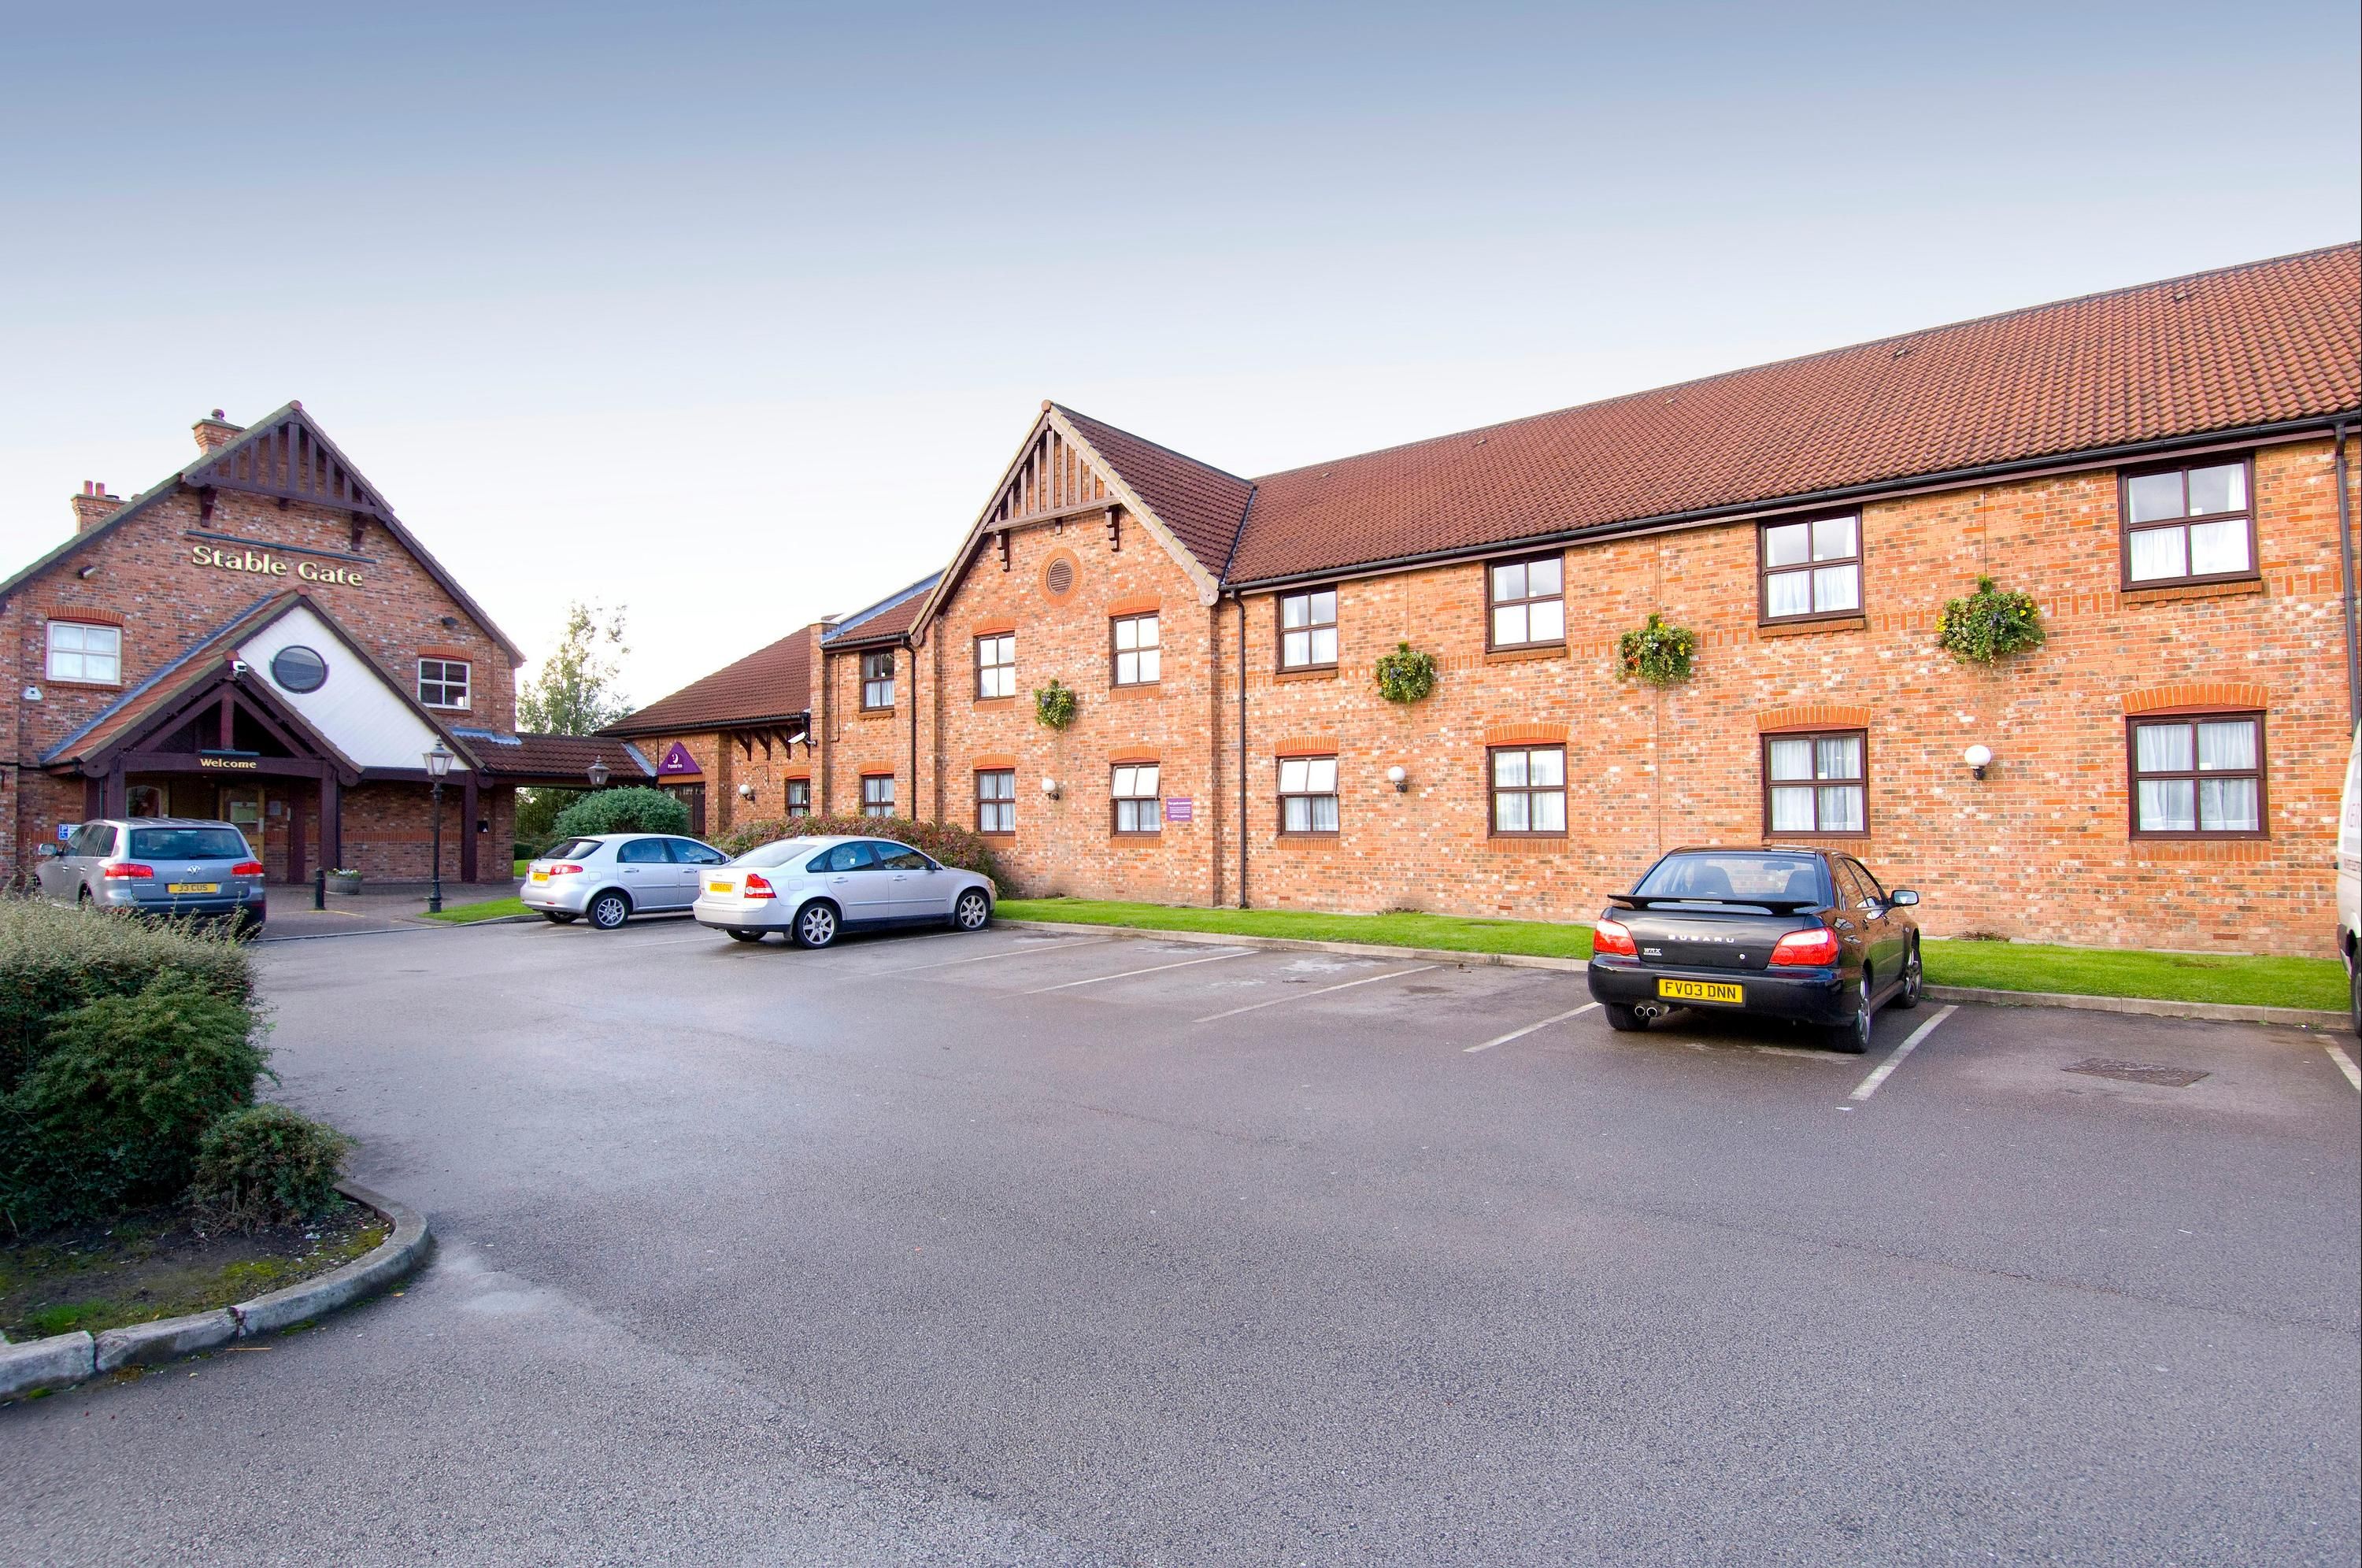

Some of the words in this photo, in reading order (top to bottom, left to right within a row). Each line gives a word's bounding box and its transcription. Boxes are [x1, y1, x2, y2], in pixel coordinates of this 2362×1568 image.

[192, 545, 287, 575] Stable
[298, 561, 363, 586] Gate
[200, 758, 257, 768] Welcome
[1668, 934, 1734, 944] SUBARU
[1665, 982, 1703, 997] FV03
[1708, 985, 1736, 1000] DNN
